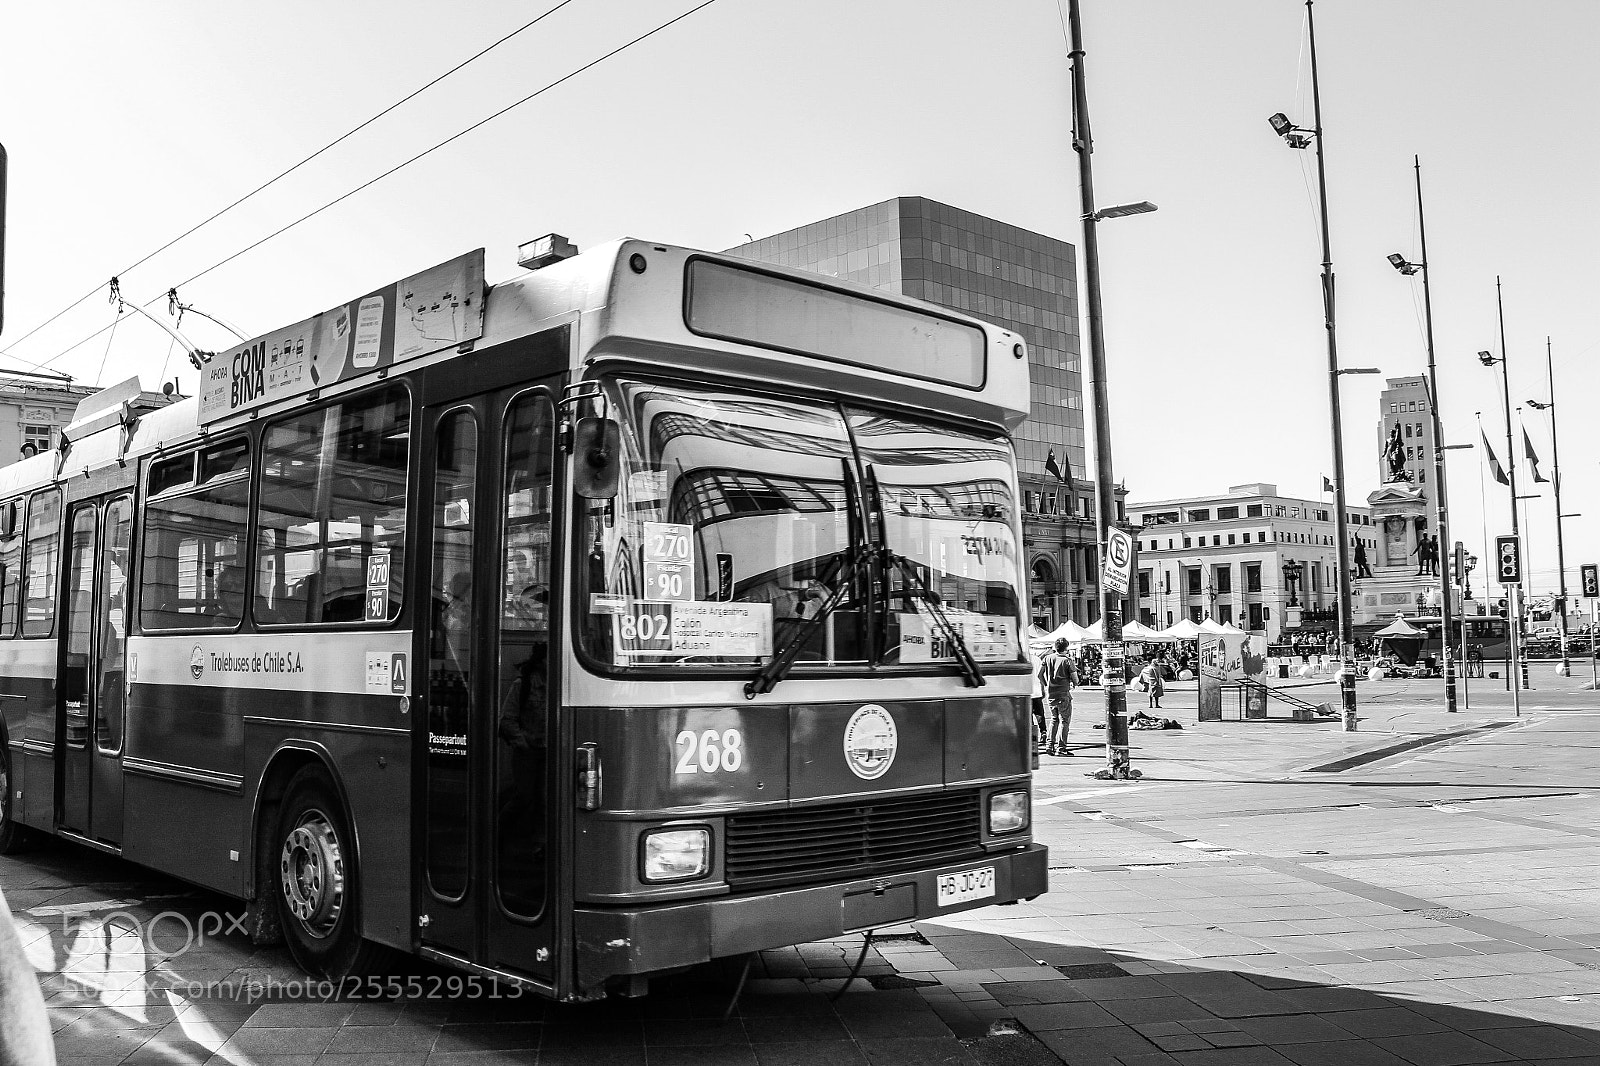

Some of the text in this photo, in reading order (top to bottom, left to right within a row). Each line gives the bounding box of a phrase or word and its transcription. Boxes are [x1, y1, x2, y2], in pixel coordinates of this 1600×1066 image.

[232, 341, 266, 381] COM
[210, 367, 228, 381] AHORA
[231, 369, 265, 409] BINA
[653, 534, 689, 558] 270
[371, 563, 388, 583] 270
[658, 573, 683, 597] 90
[371, 597, 383, 617] 90
[621, 614, 671, 641] 802
[210, 651, 304, 674] Trolebuses de Chile S.A.
[675, 729, 742, 774] 268
